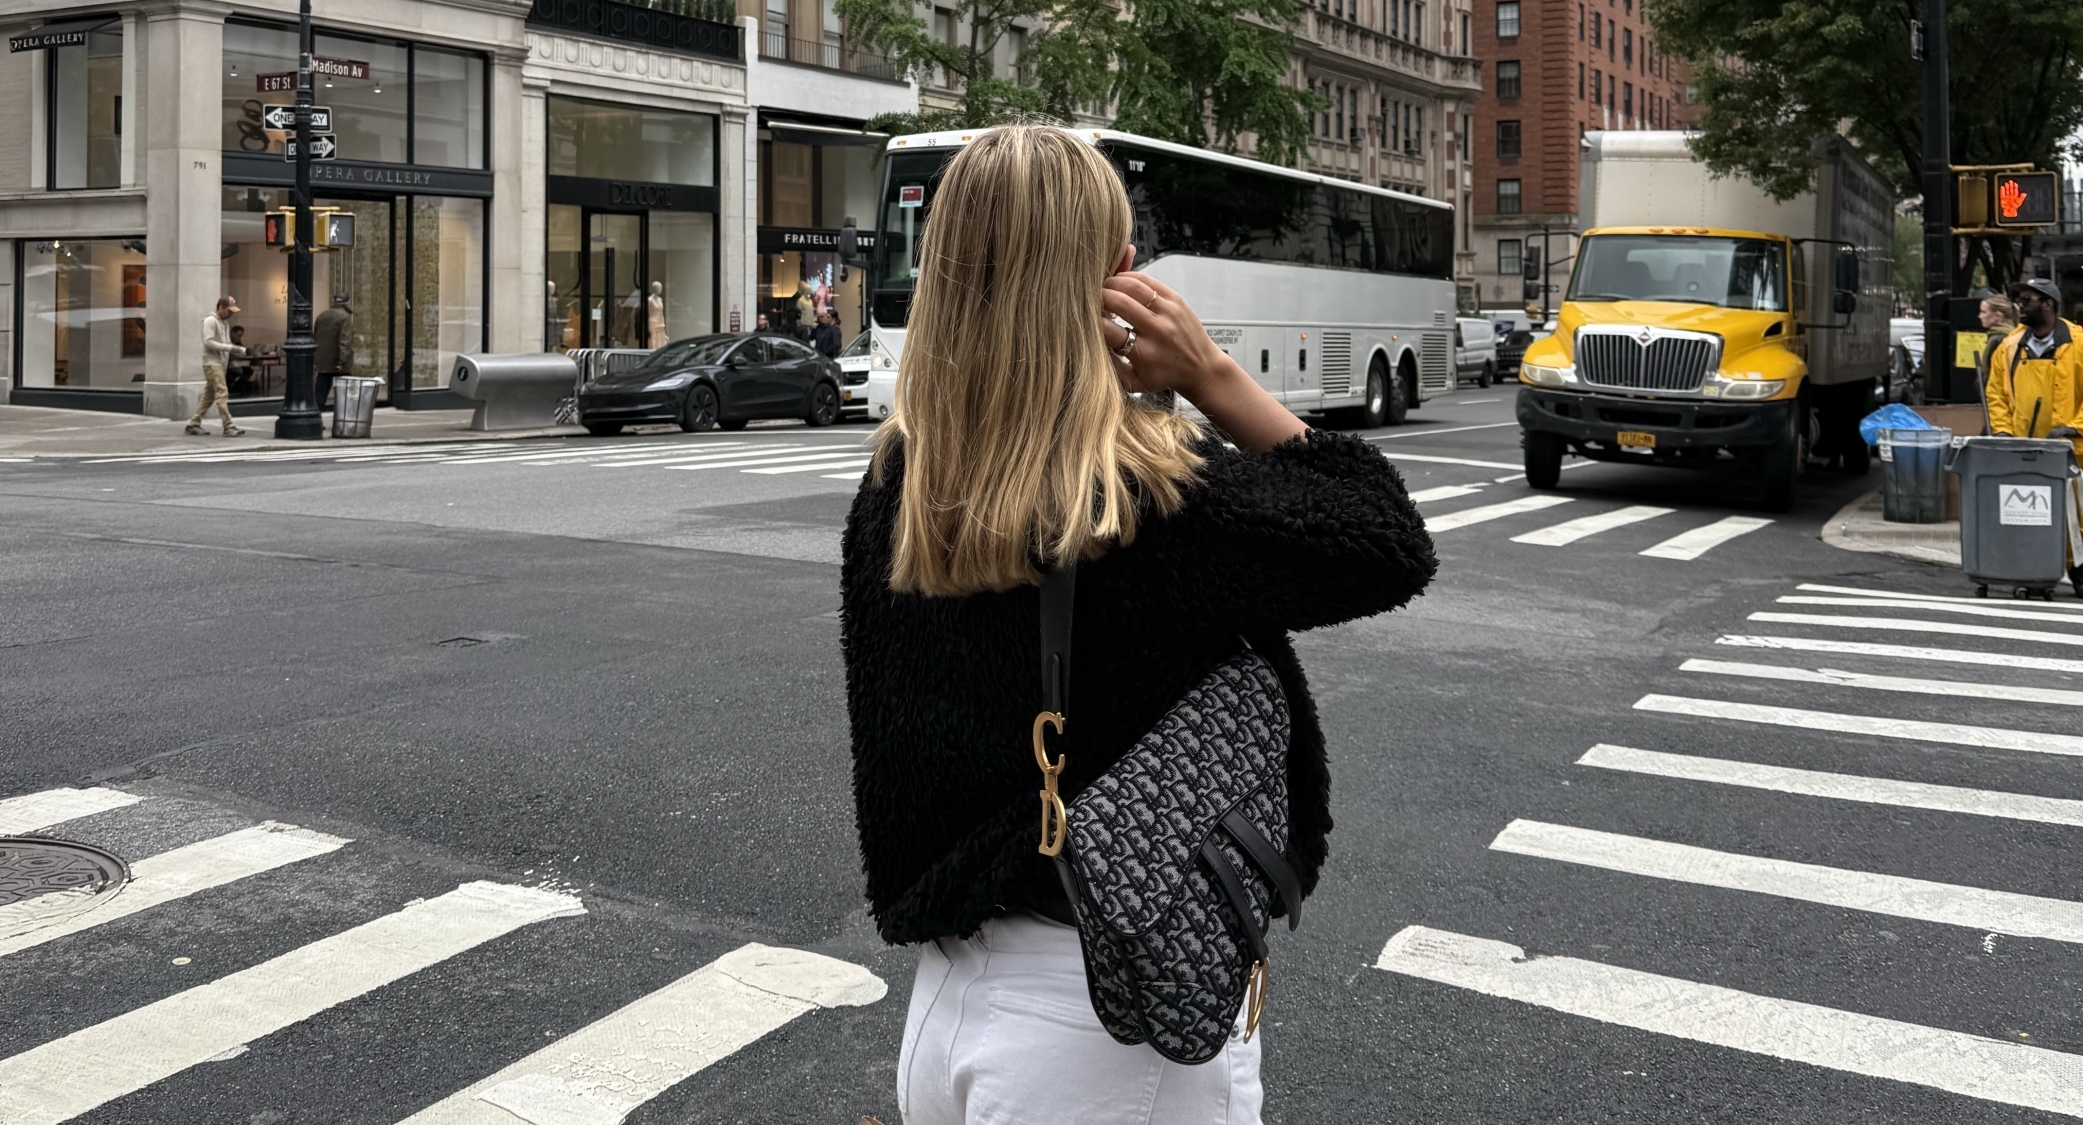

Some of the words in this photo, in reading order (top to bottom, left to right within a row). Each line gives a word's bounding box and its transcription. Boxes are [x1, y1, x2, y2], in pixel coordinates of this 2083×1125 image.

[10, 38, 40, 51] OPERA
[43, 33, 85, 45] GALLERY
[312, 60, 349, 76] Madison
[352, 65, 363, 78] Av
[264, 78, 270, 91] E
[271, 77, 281, 90] 67
[283, 76, 291, 89] St
[273, 113, 294, 123] ONE
[312, 143, 329, 152] WAY
[927, 138, 937, 147] 55
[193, 161, 207, 170] 791
[310, 166, 355, 180] PERA
[364, 169, 431, 185] GALLERY
[784, 233, 837, 245] FRATELLI
